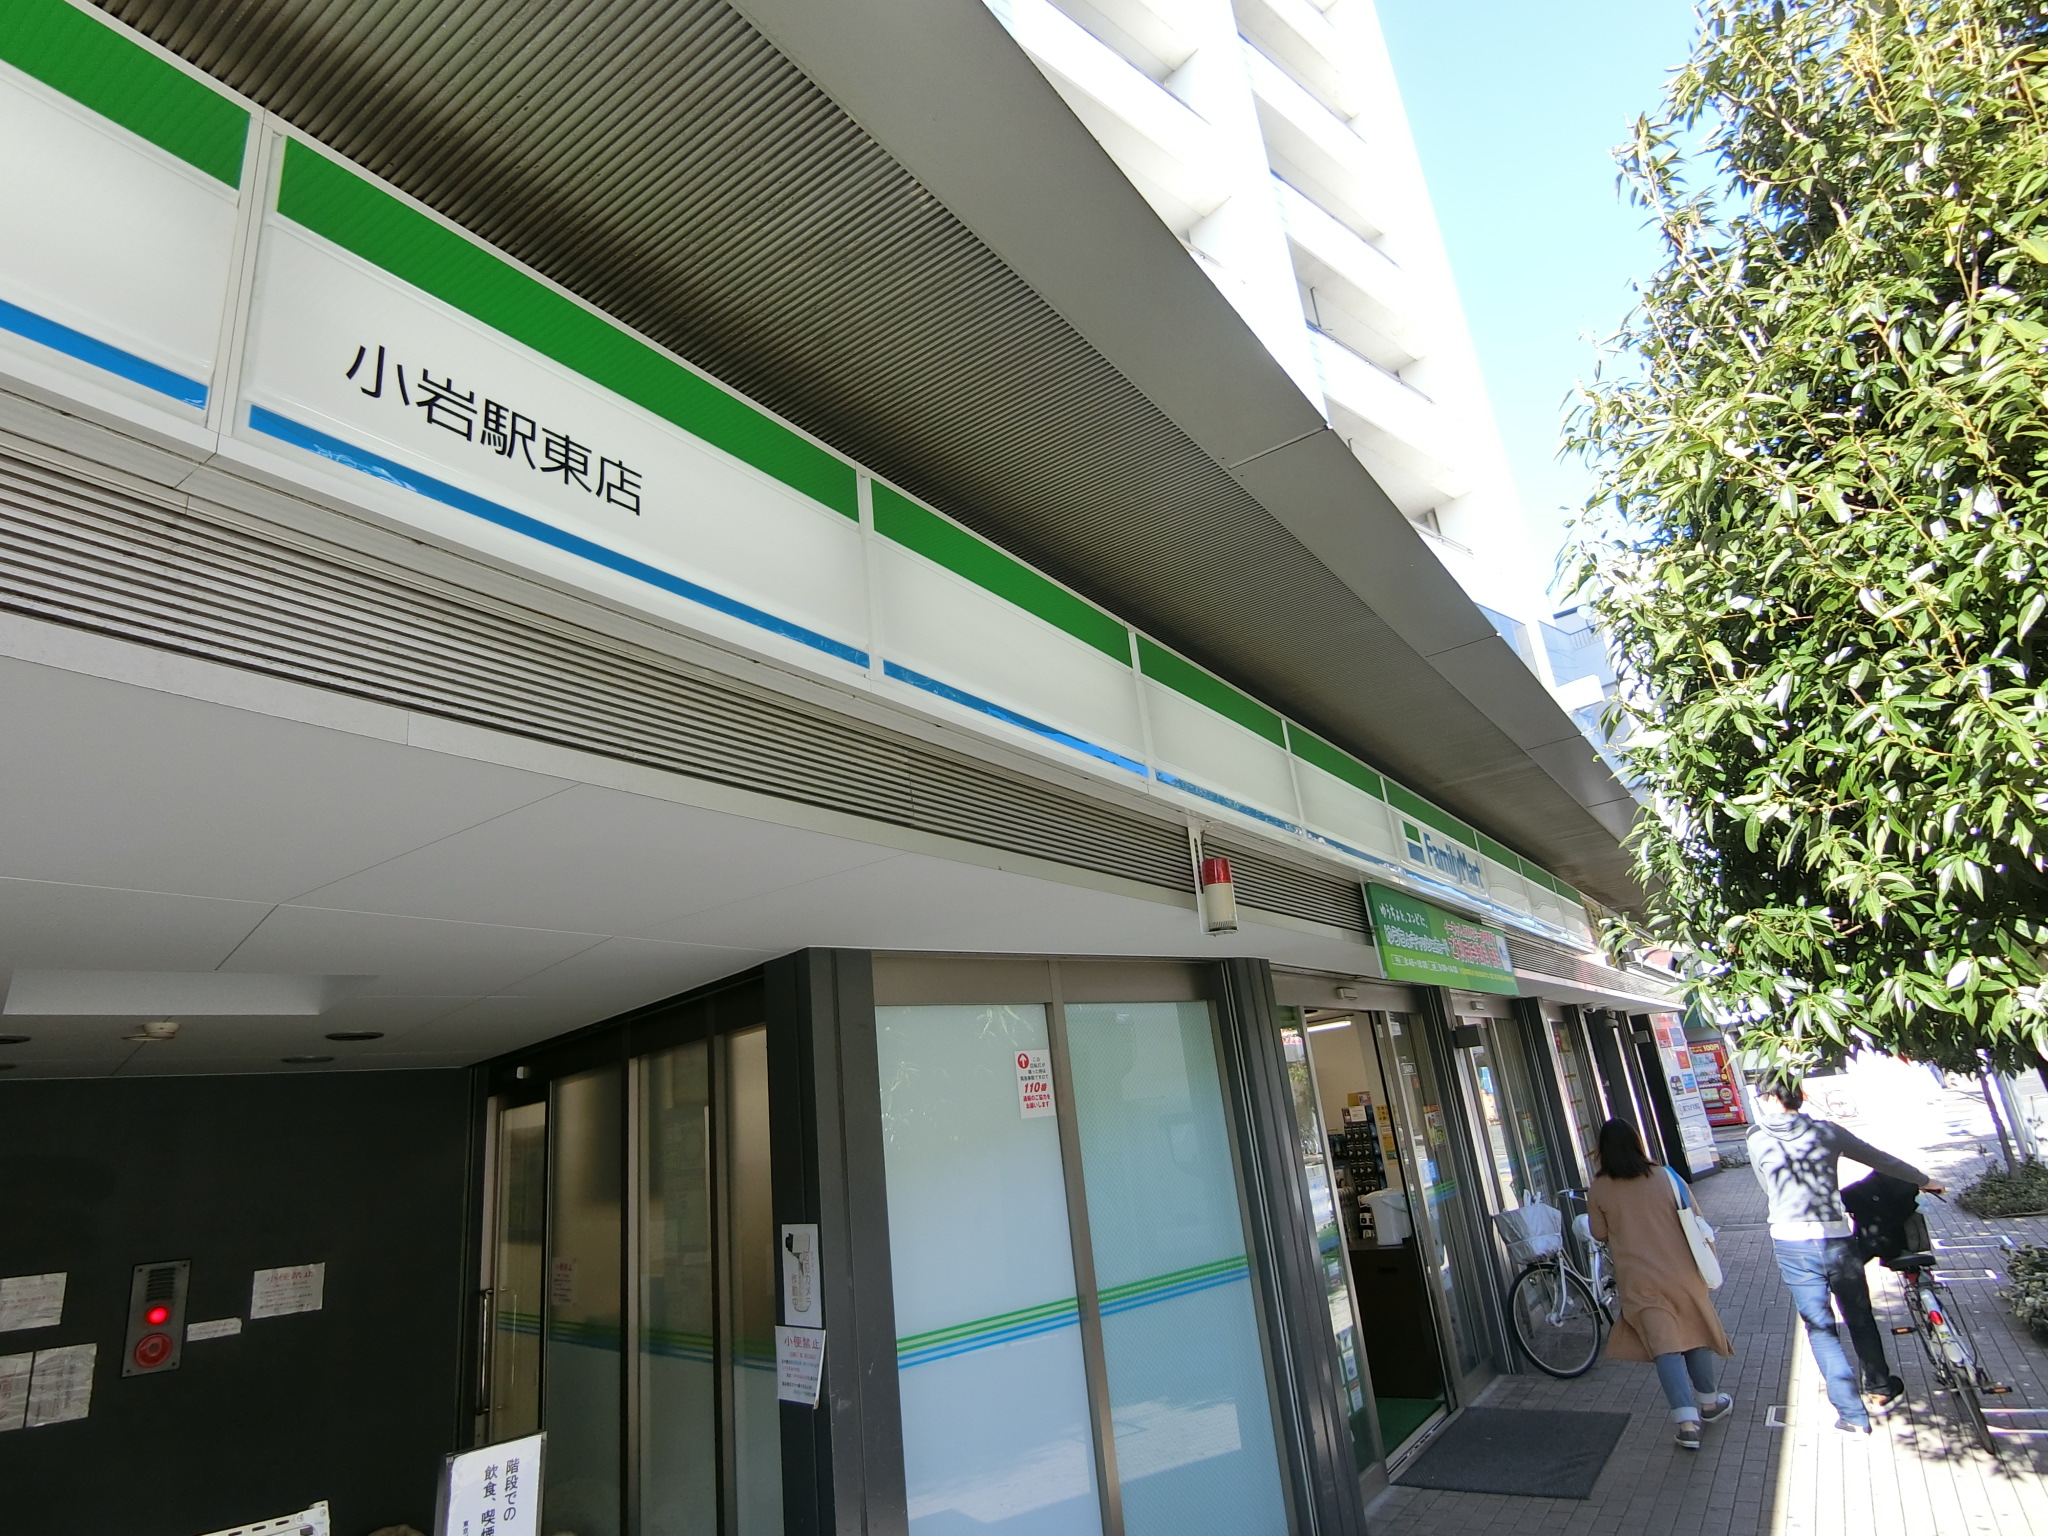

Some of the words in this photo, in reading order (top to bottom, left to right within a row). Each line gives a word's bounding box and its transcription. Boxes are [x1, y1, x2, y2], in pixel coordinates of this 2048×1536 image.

[346, 345, 642, 516] 小岩駅東店
[1423, 832, 1484, 889] FamilyMart
[1024, 1082, 1047, 1093] 110番
[1026, 1101, 1049, 1109] お願いします
[784, 1336, 821, 1350] 小便禁止
[503, 1458, 520, 1521] 階段での
